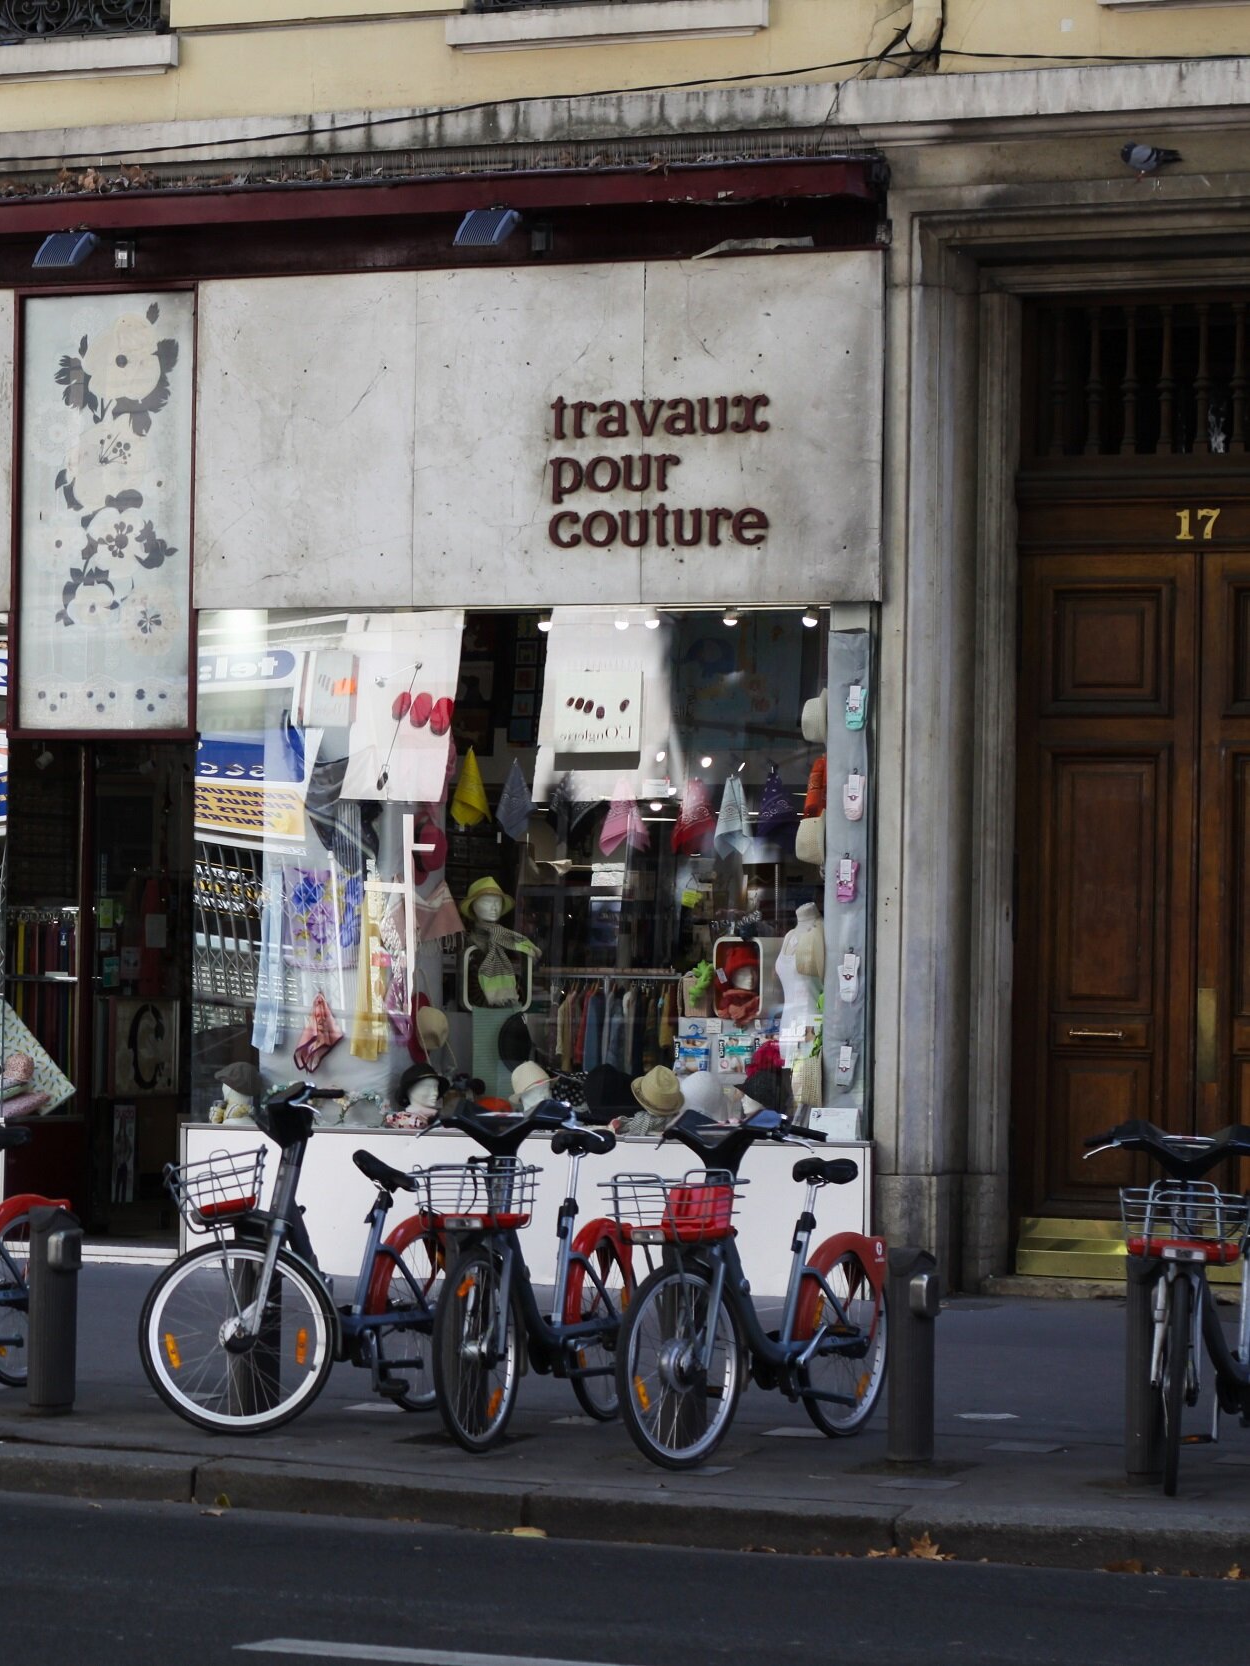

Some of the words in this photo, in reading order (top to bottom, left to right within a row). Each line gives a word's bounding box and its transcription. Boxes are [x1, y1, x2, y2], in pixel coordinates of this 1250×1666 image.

[551, 395, 770, 440] travaux
[550, 453, 681, 504] pour
[549, 503, 769, 548] couture
[1175, 509, 1220, 540] 17
